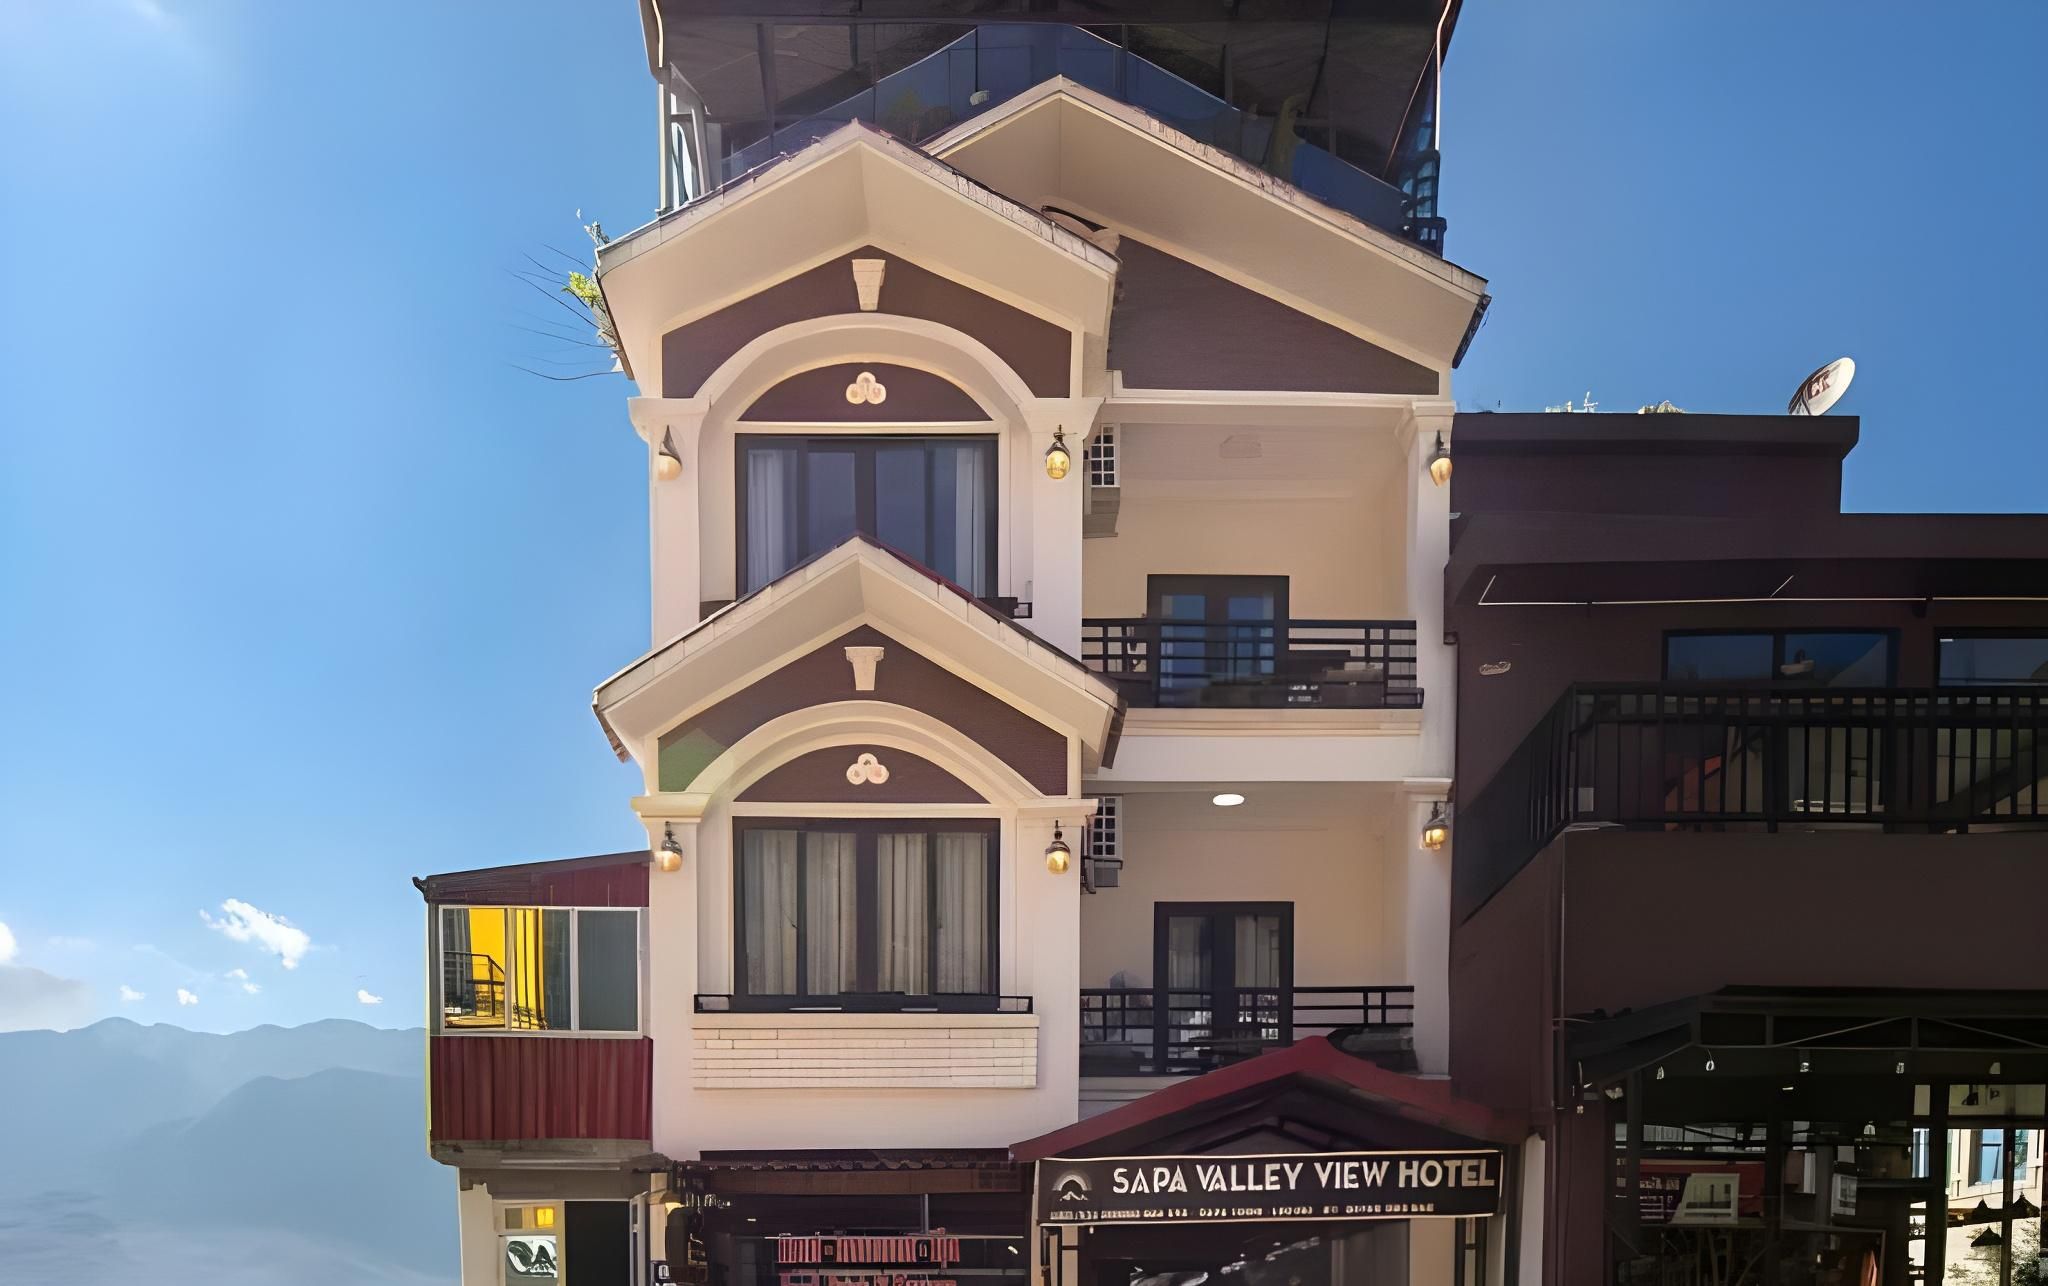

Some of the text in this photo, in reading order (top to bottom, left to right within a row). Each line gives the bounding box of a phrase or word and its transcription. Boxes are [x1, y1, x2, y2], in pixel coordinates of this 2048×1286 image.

[1112, 1158, 1495, 1195] SAPA VALLEY VIEW HOTEL
